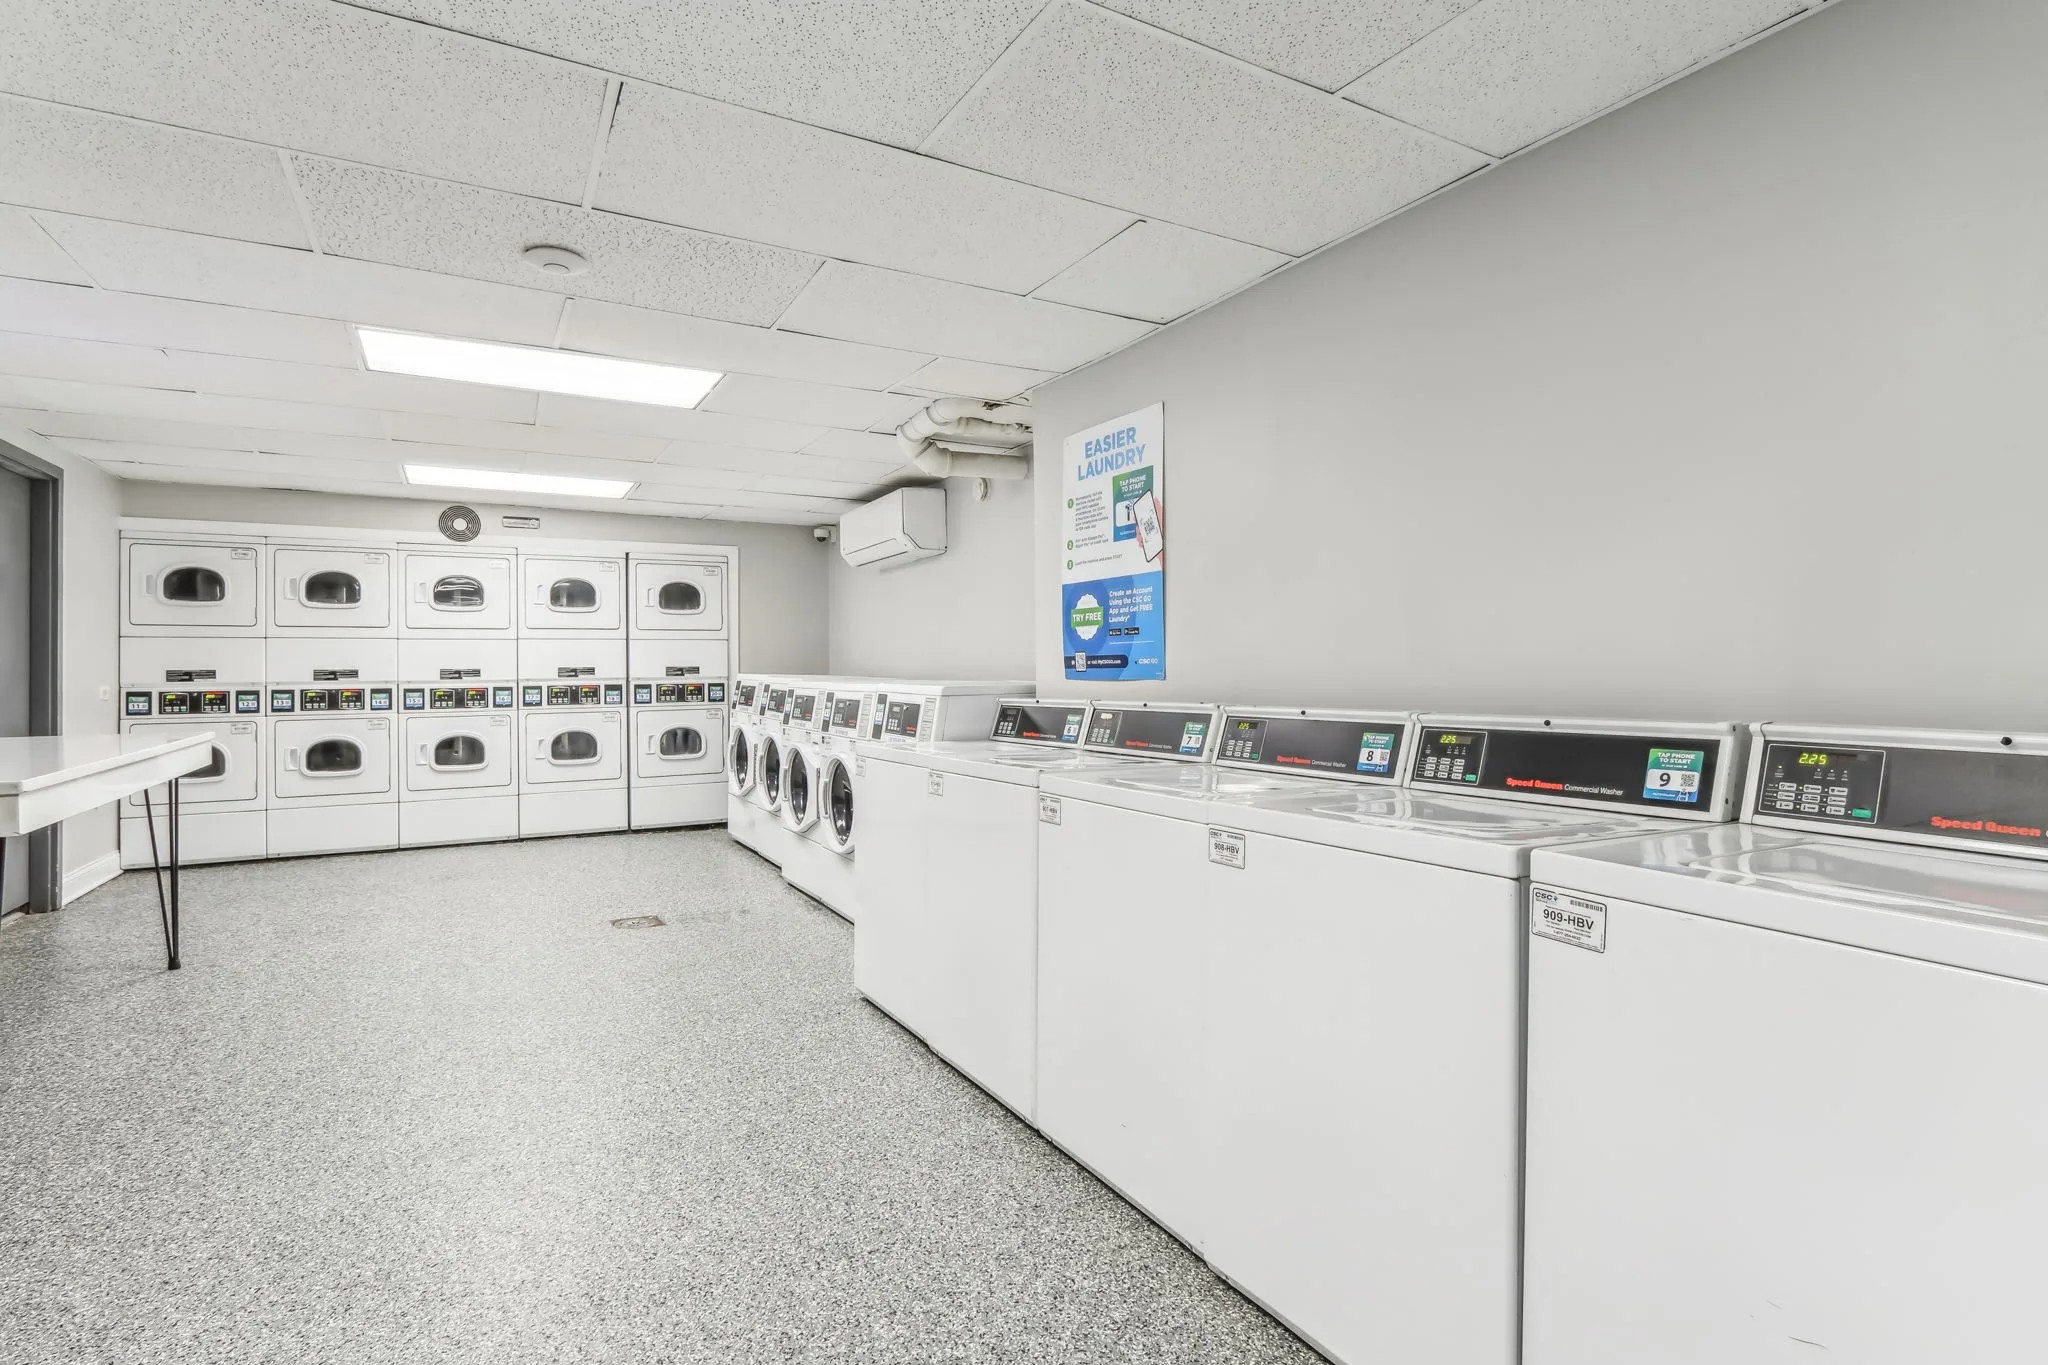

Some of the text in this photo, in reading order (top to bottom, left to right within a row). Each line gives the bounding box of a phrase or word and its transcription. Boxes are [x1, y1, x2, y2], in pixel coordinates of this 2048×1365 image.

[1084, 427, 1137, 459] EASIER
[1078, 443, 1146, 481] LAUNDRY
[1129, 481, 1145, 490] START
[1073, 611, 1102, 623] TRY FREE
[1186, 736, 1192, 745] 7
[1366, 750, 1374, 761] 8
[1506, 777, 1534, 787] Speed
[1564, 783, 1599, 794] Commercial
[1600, 787, 1624, 796] Washer
[1659, 772, 1671, 787] 9
[1930, 816, 1984, 830] Speed
[1985, 821, 2042, 837] Queen
[1535, 891, 1553, 901] CSC
[1543, 908, 1594, 930] 909-HBV
